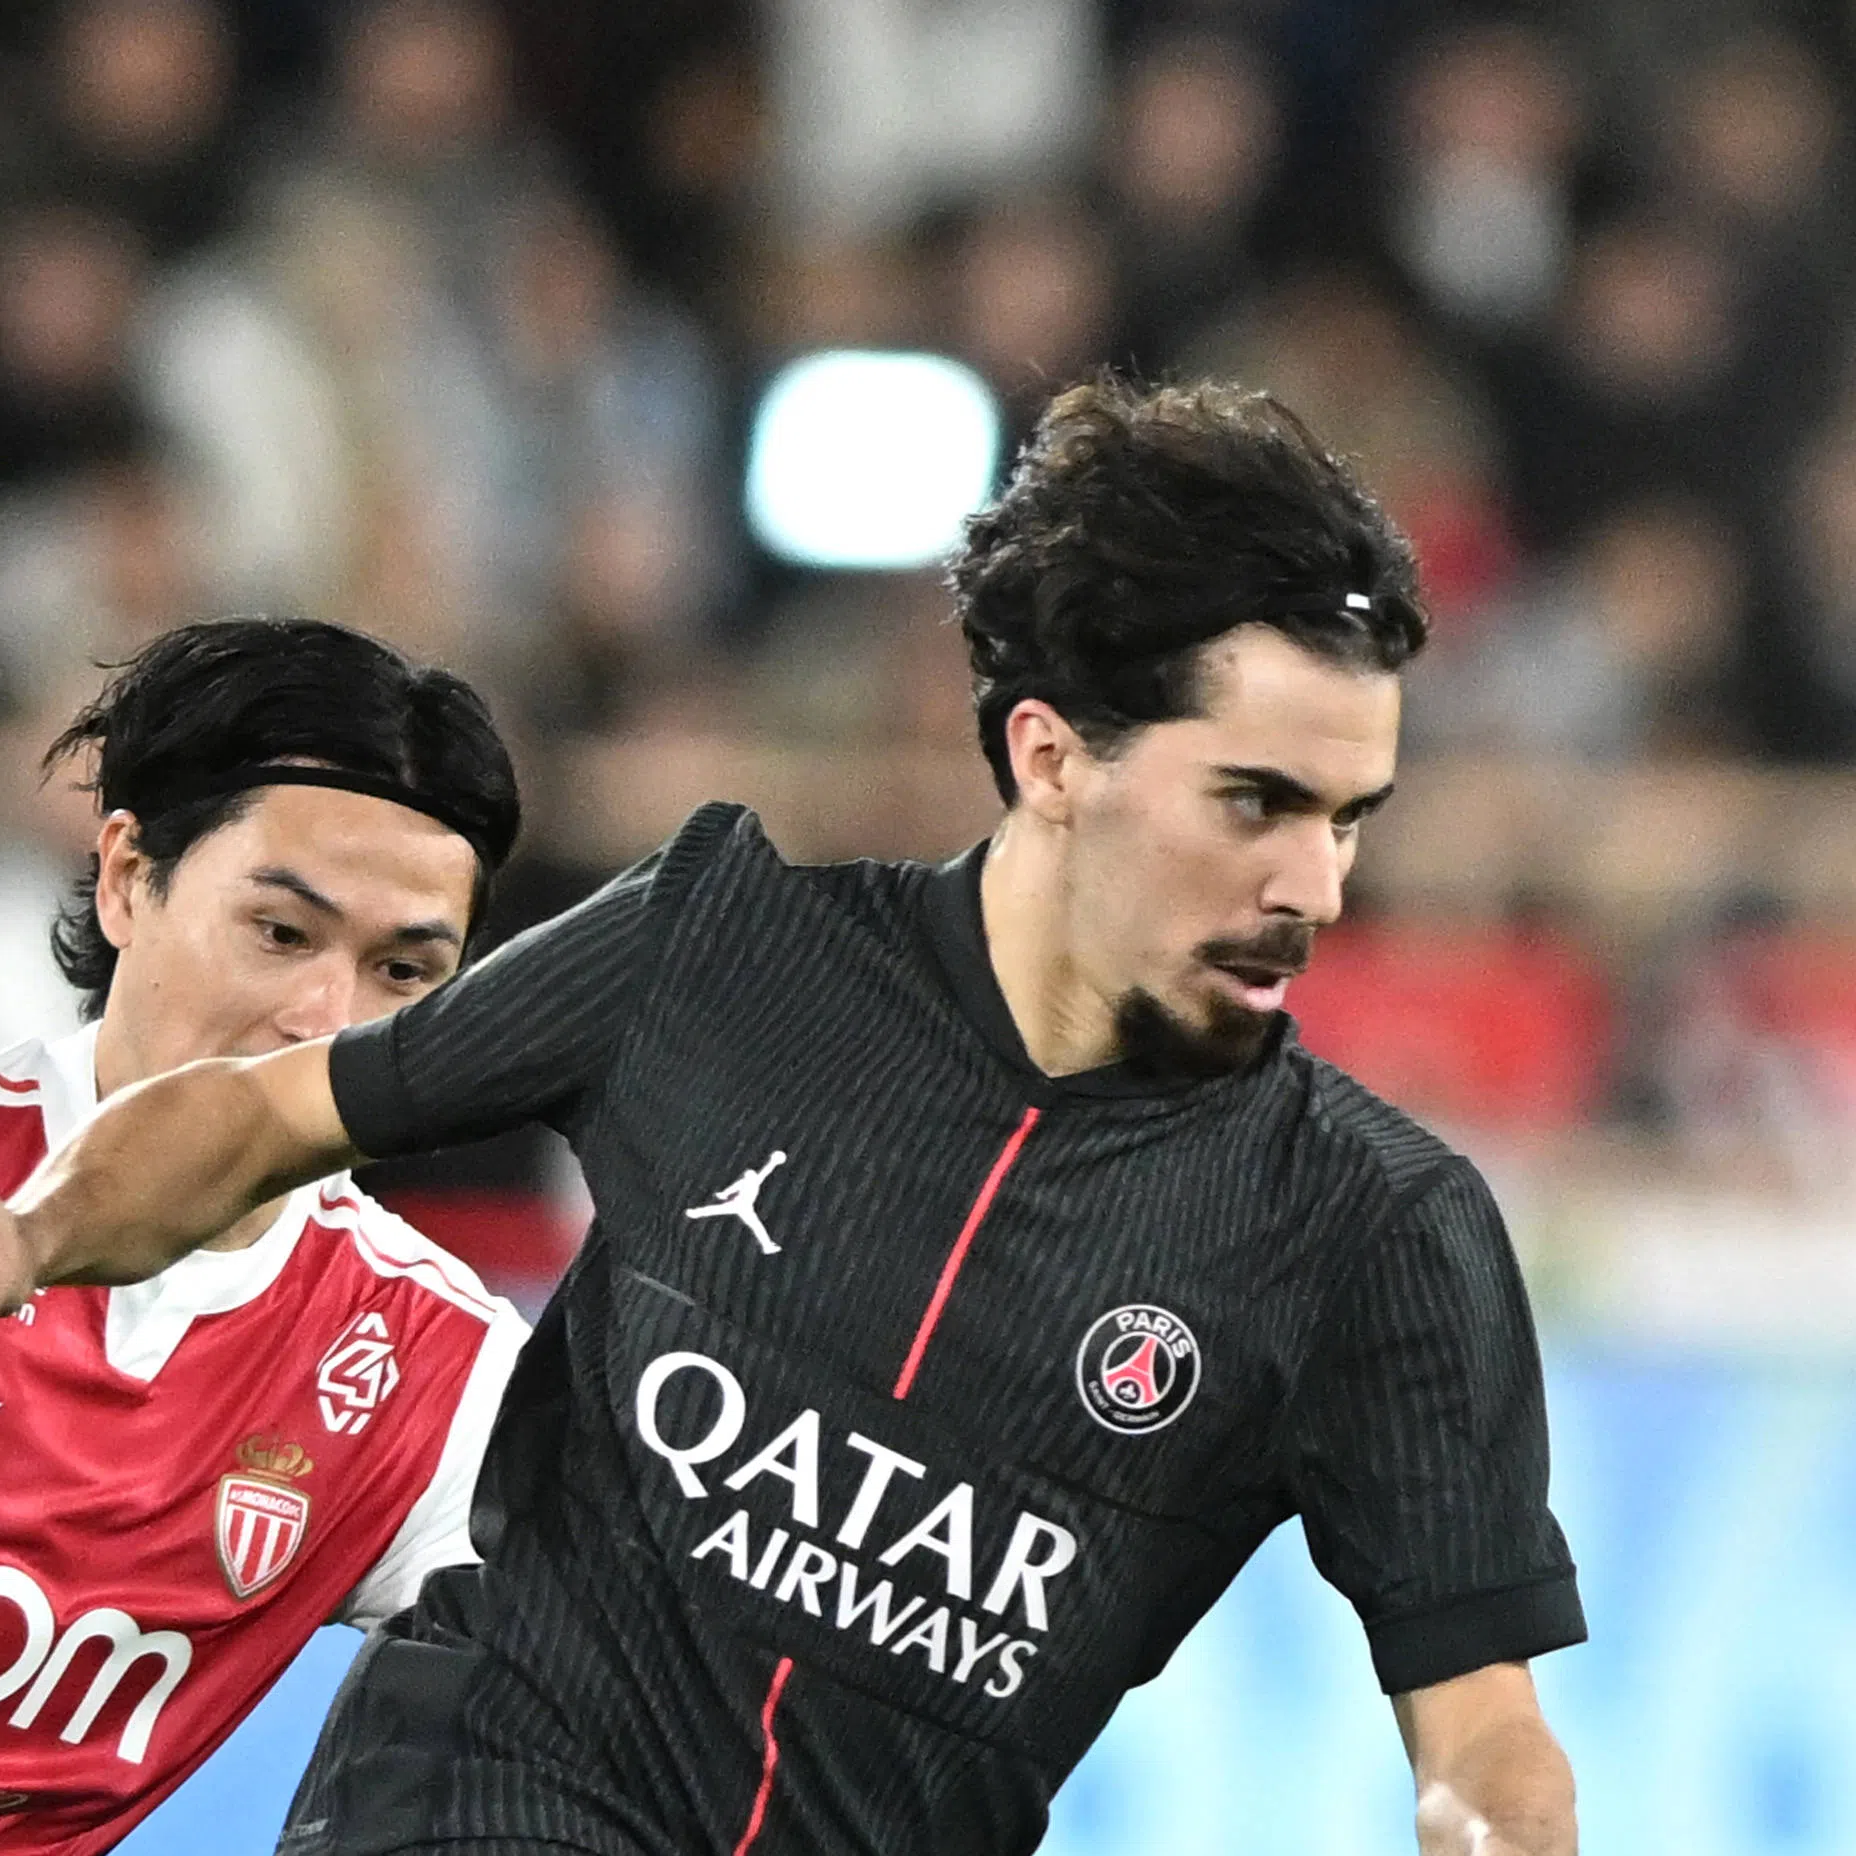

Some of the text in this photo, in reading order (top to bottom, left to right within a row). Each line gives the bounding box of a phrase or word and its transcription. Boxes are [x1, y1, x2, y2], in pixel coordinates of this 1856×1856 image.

[1115, 1311, 1194, 1360] PARIS
[635, 1350, 1078, 1632] QATAR
[690, 1508, 1039, 1698] AIRWAYS
